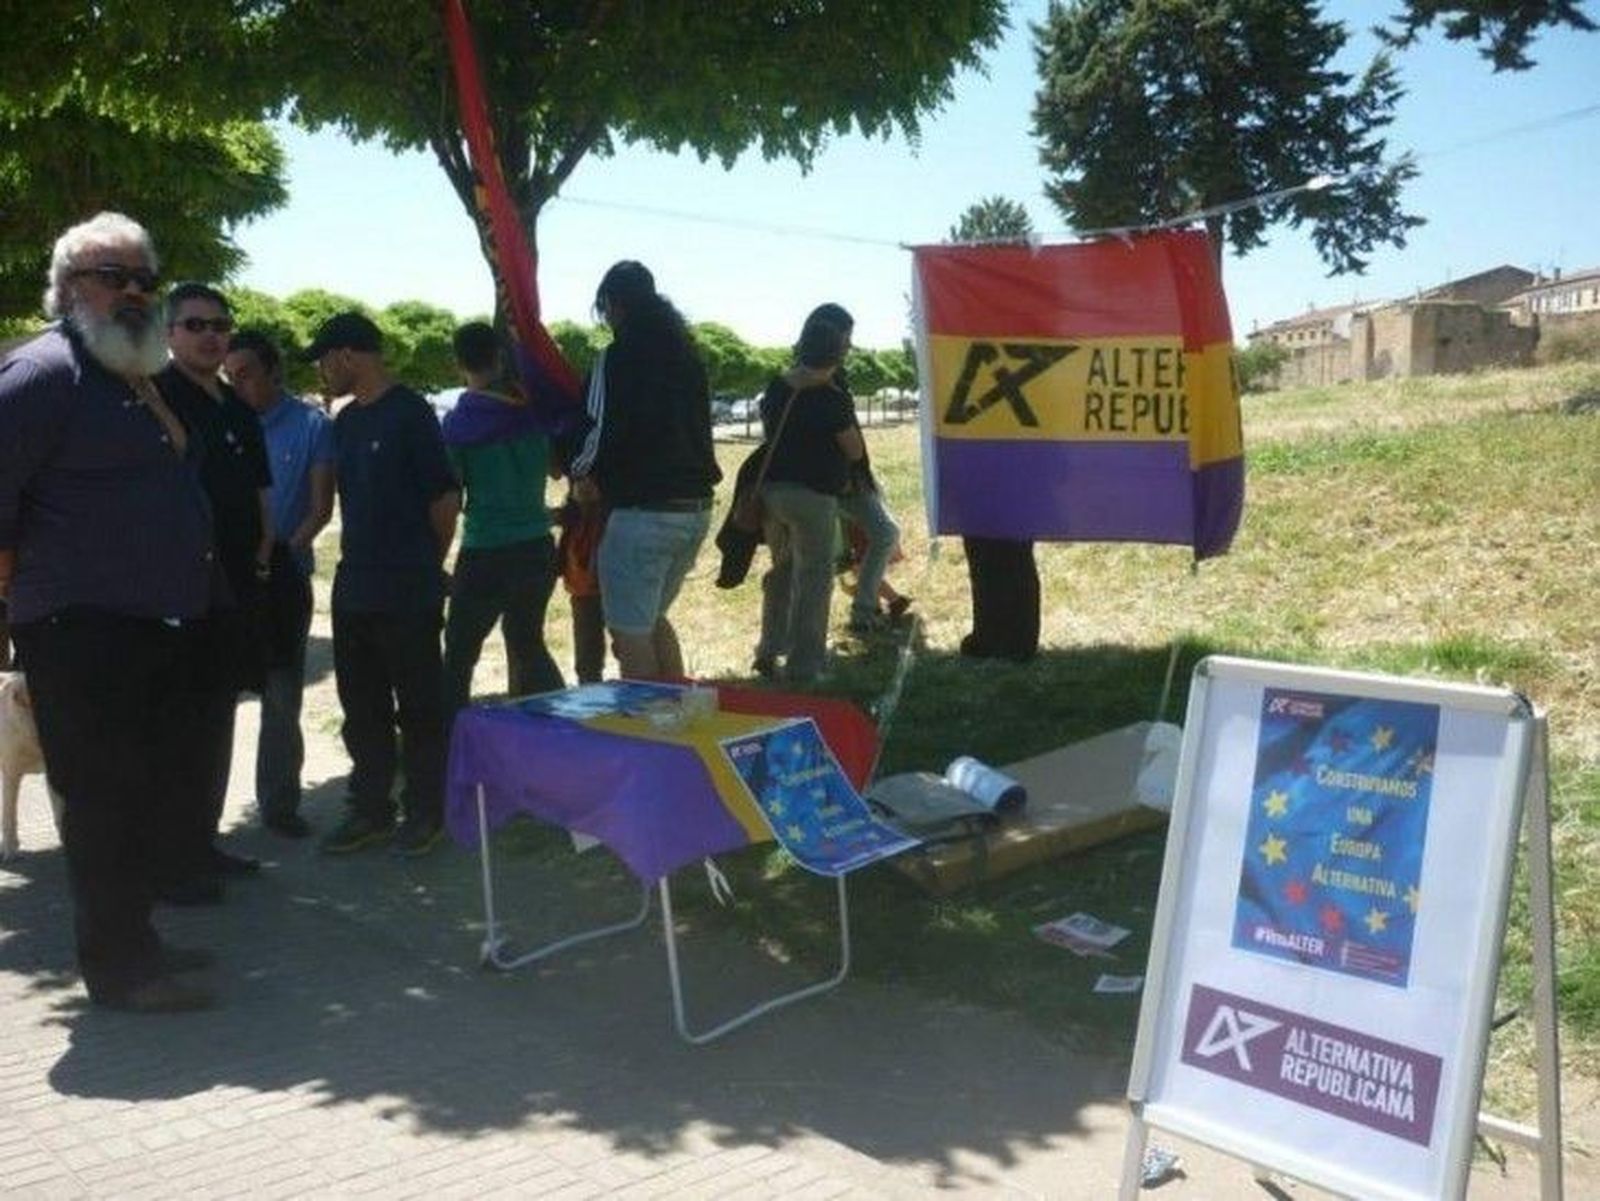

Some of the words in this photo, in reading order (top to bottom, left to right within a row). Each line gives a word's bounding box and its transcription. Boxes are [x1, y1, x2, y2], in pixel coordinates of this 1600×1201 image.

[1311, 863, 1396, 898] ALTERNATIVA
[1280, 1053, 1415, 1122] REPUBLICANA
[1283, 1027, 1414, 1091] ALTERNATIVA
